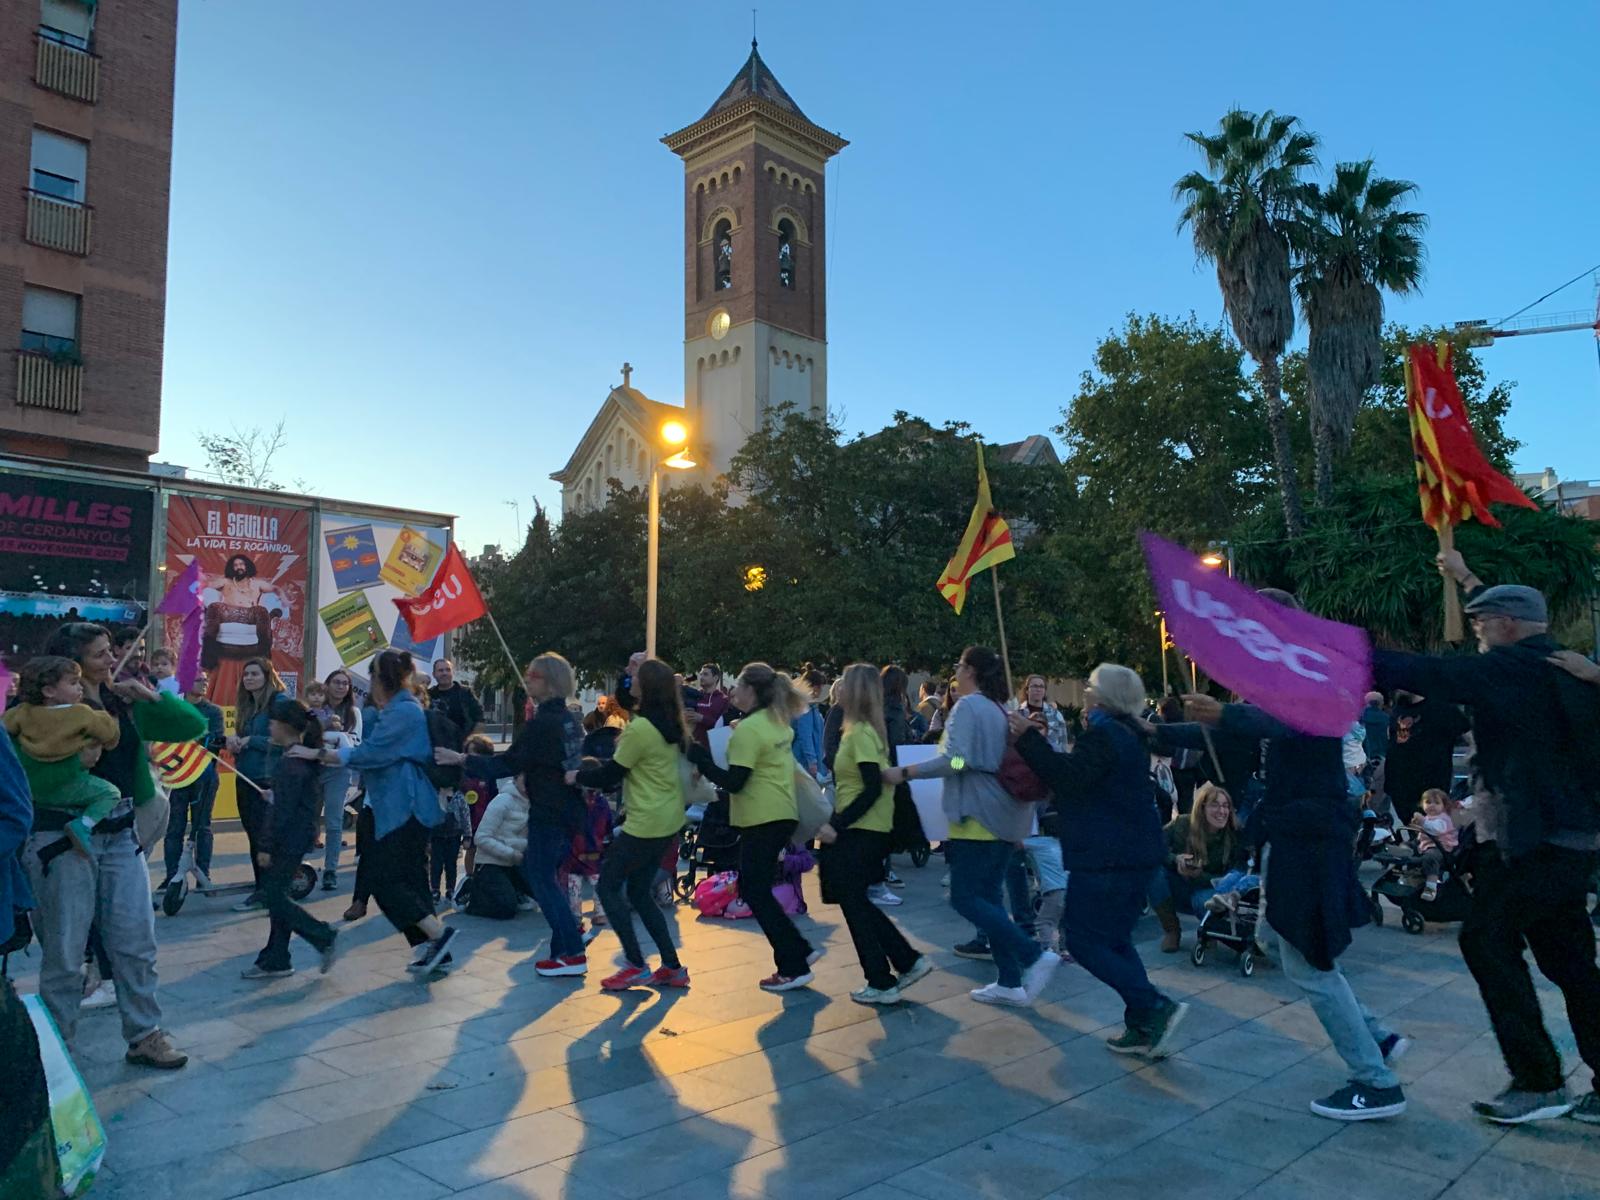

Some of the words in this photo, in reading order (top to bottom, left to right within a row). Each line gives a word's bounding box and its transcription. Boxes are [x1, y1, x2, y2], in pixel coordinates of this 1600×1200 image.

[0, 492, 132, 529] MILLES
[21, 522, 132, 544] CERDANYOLA
[207, 511, 222, 535] EL
[187, 538, 201, 548] LA
[203, 538, 227, 550] VIDA
[229, 541, 242, 550] ES
[244, 541, 294, 553] ROCANROL
